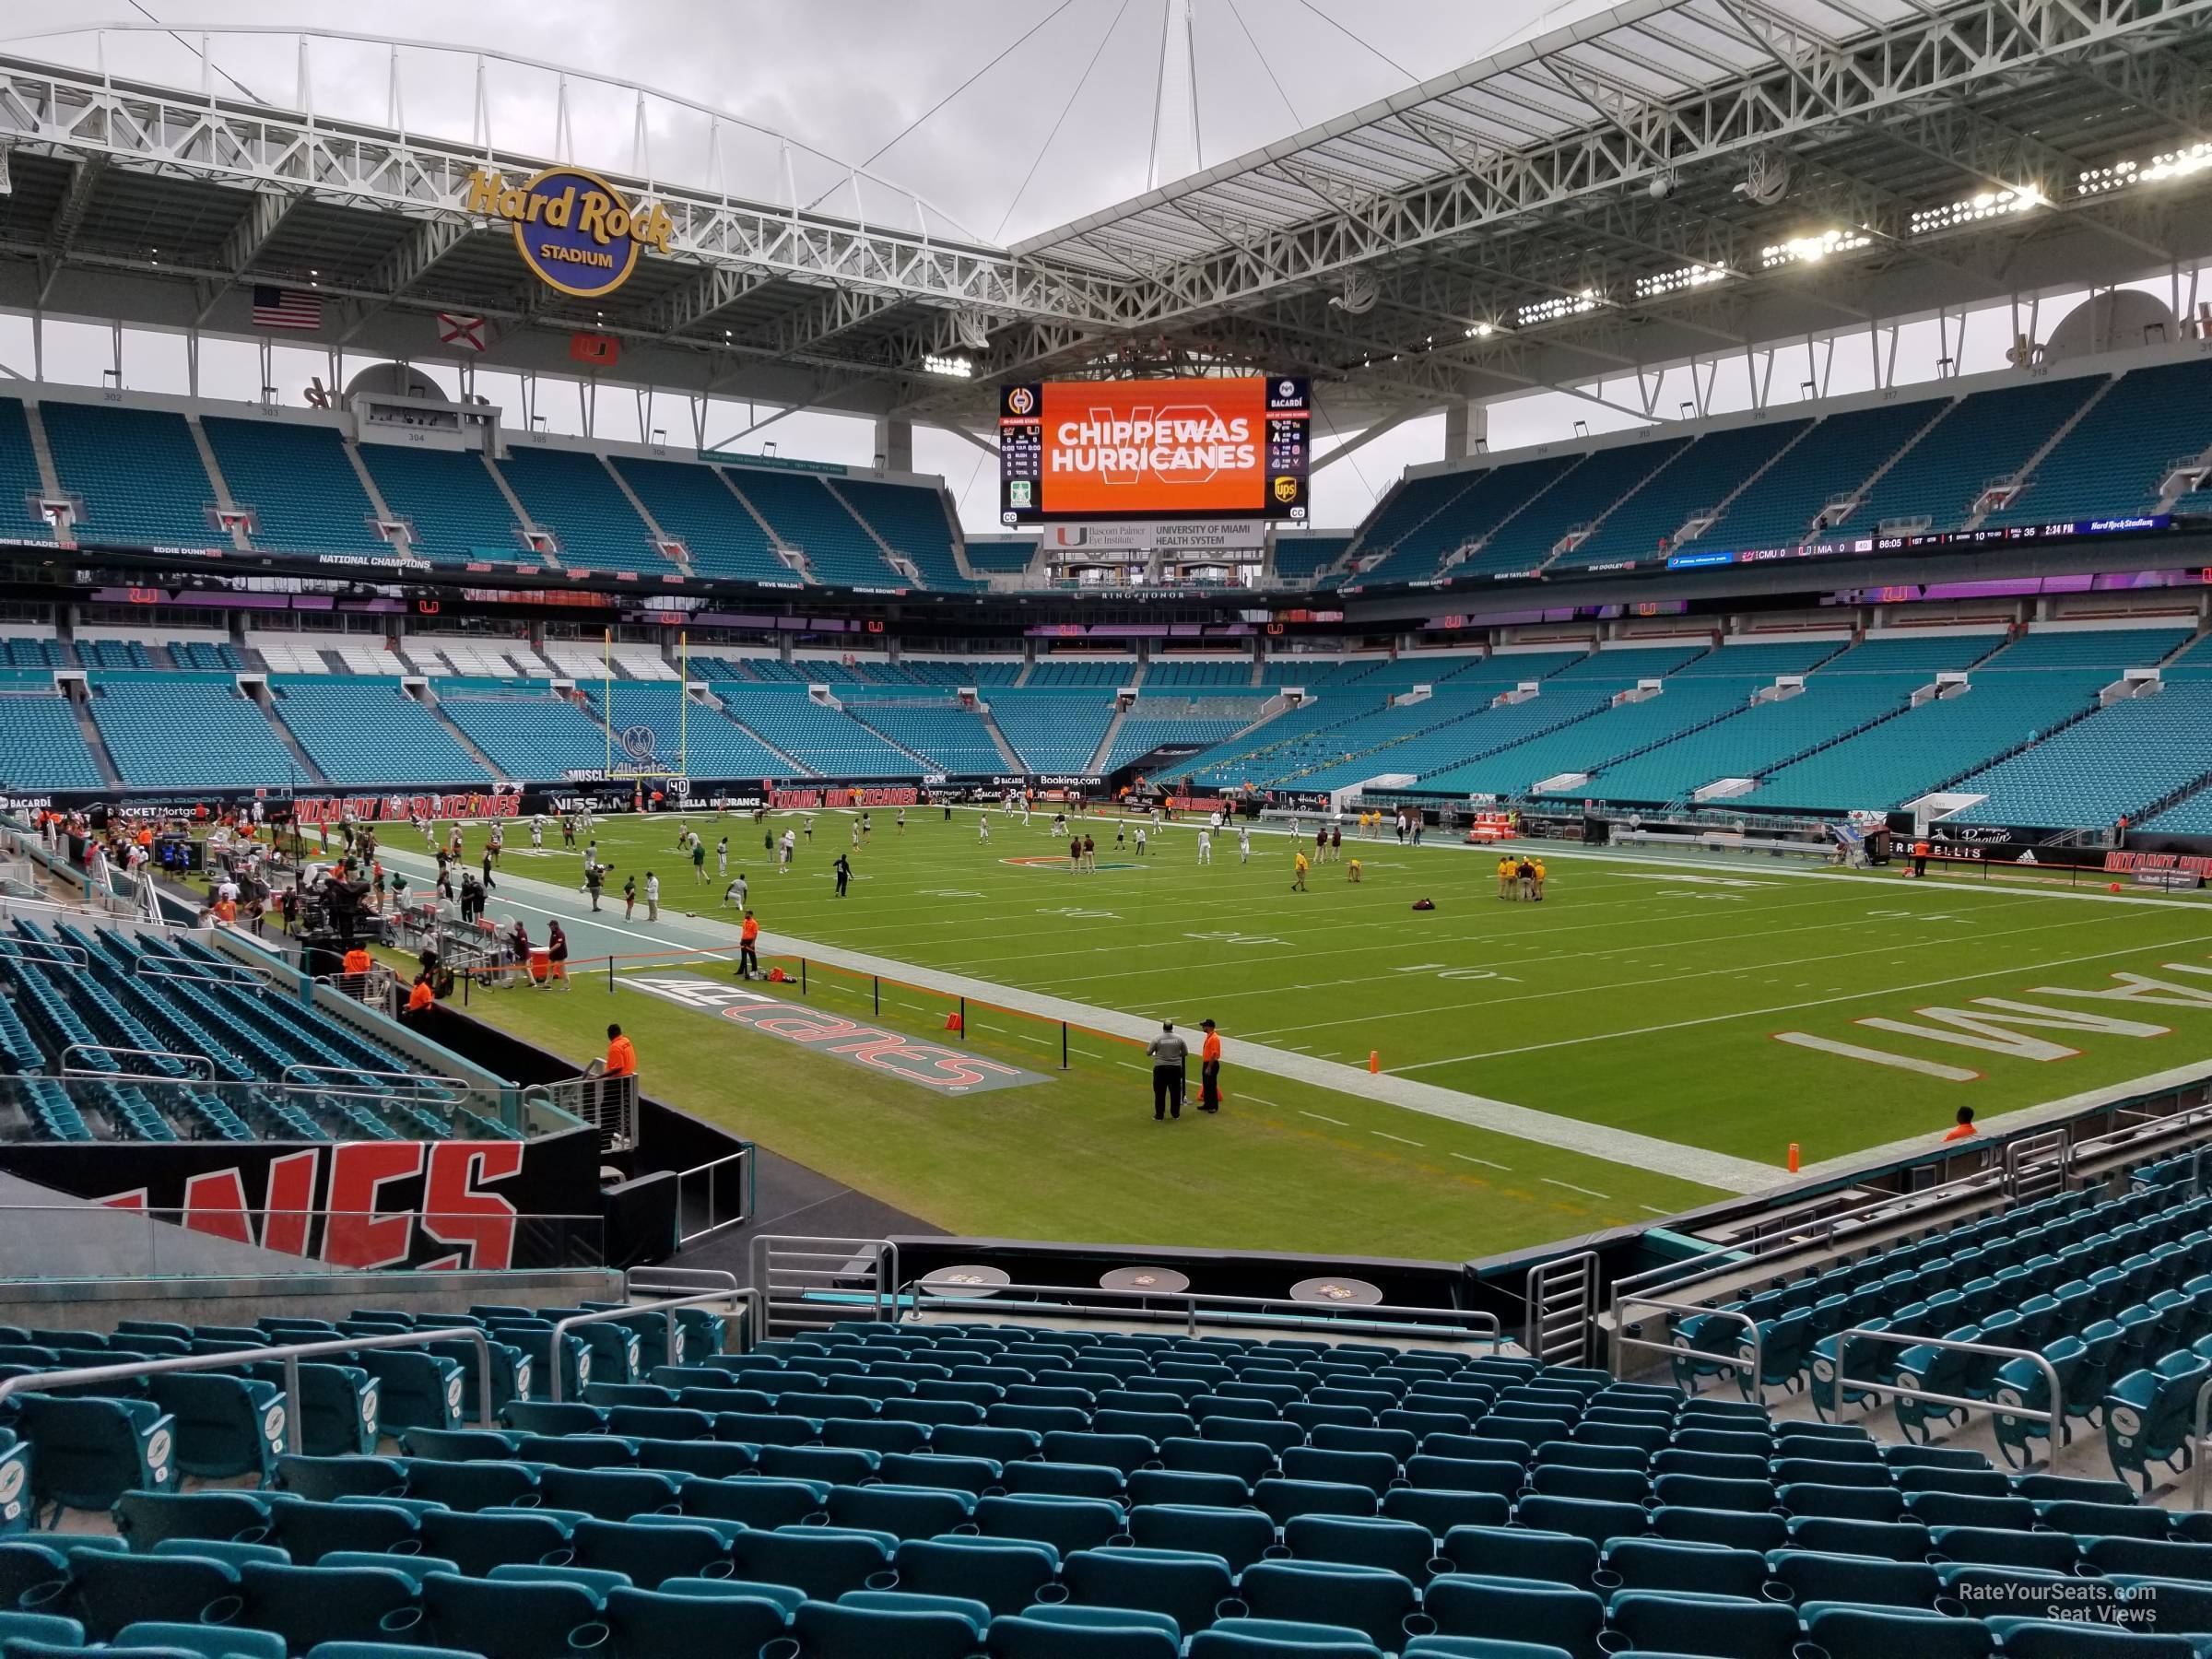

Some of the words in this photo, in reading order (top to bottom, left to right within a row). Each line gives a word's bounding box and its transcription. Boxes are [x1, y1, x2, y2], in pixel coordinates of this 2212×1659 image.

[467, 170, 575, 228] Hard
[578, 190, 674, 254] Rock
[540, 243, 613, 268] STADIUM
[104, 393, 122, 402] 302
[1271, 397, 1302, 407] BACARDÍ
[262, 408, 279, 417] 303
[408, 433, 425, 441] 304
[1057, 418, 1250, 446] CHIPPEWAS
[532, 435, 547, 443] 305
[653, 448, 666, 456] 306
[1052, 445, 1255, 472] HURRICANES
[1277, 485, 1295, 499] ups
[1291, 509, 1304, 517] CC
[1156, 525, 1205, 535] UNIVERSITY
[1207, 525, 1219, 534] OF
[1221, 524, 1251, 534] MIAMI
[2063, 523, 2074, 534] PM
[2091, 522, 2108, 531] Hard
[2108, 521, 2124, 531] Rock
[2124, 518, 2153, 528] Stadium
[1088, 526, 1119, 535] Bascom
[1119, 526, 1145, 536] Palmer
[2024, 527, 2035, 537] 35
[23, 539, 60, 548] BLADES
[1088, 535, 1102, 546] Eye
[1102, 535, 1135, 545] Institute
[1156, 536, 1188, 546] HEALTH
[1191, 535, 1225, 545] SYSTEM
[1759, 549, 1777, 559] CMU
[1780, 549, 1785, 558] 0
[1818, 546, 1832, 554] MIA
[1879, 539, 1902, 548] 86:05
[1947, 534, 1953, 542] 1
[1974, 532, 1985, 541] 10
[153, 547, 180, 555] EDDIE
[181, 547, 206, 556] DUNN
[319, 554, 370, 566] NATIONAL
[371, 557, 431, 570] CHAMPIONS
[569, 769, 609, 782] MUSCLE
[1001, 776, 1025, 784] BACARDÍ
[1041, 775, 1100, 786] Booking.com
[669, 781, 687, 793] 40
[10, 796, 52, 807] BACARDÍ
[554, 798, 630, 810] NISSAN
[710, 797, 760, 806] INURANCE
[158, 806, 210, 818] Mortgae
[1934, 845, 1981, 858] ELLIS
[2104, 851, 2177, 874] MIAMI
[1386, 963, 1498, 980] 10
[6, 1504, 18, 1516] 10
